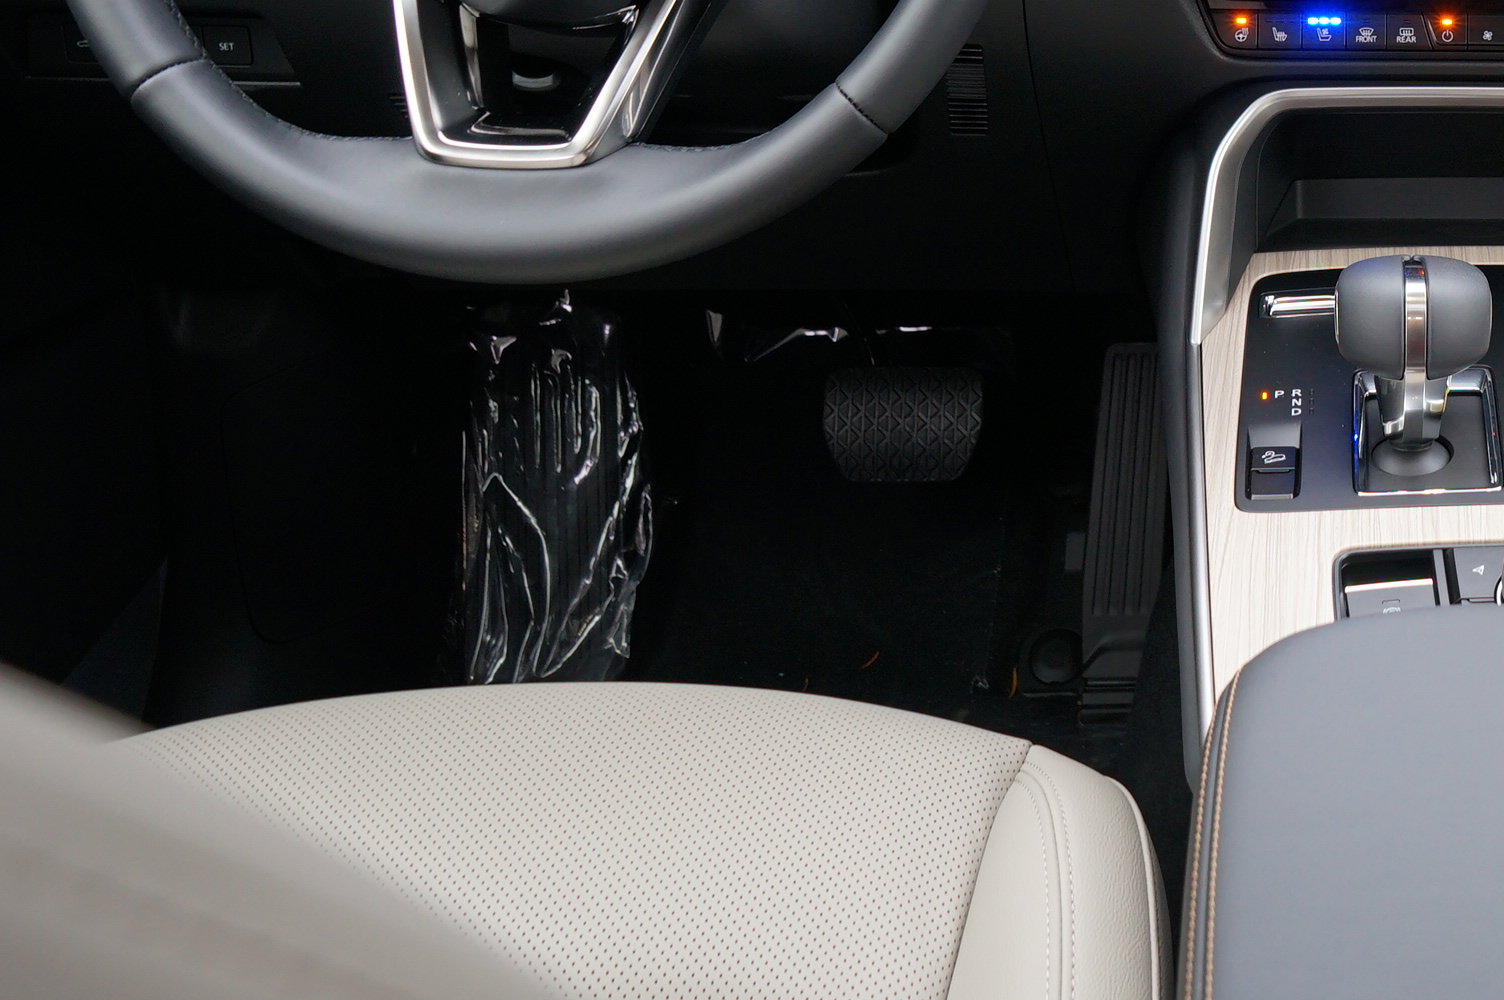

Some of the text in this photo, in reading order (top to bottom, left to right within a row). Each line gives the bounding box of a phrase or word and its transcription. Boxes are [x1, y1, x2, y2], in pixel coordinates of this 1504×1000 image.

[1355, 35, 1377, 43] FRONT
[219, 43, 234, 51] SET
[1275, 389, 1302, 399] P R
[1291, 408, 1302, 416] D
